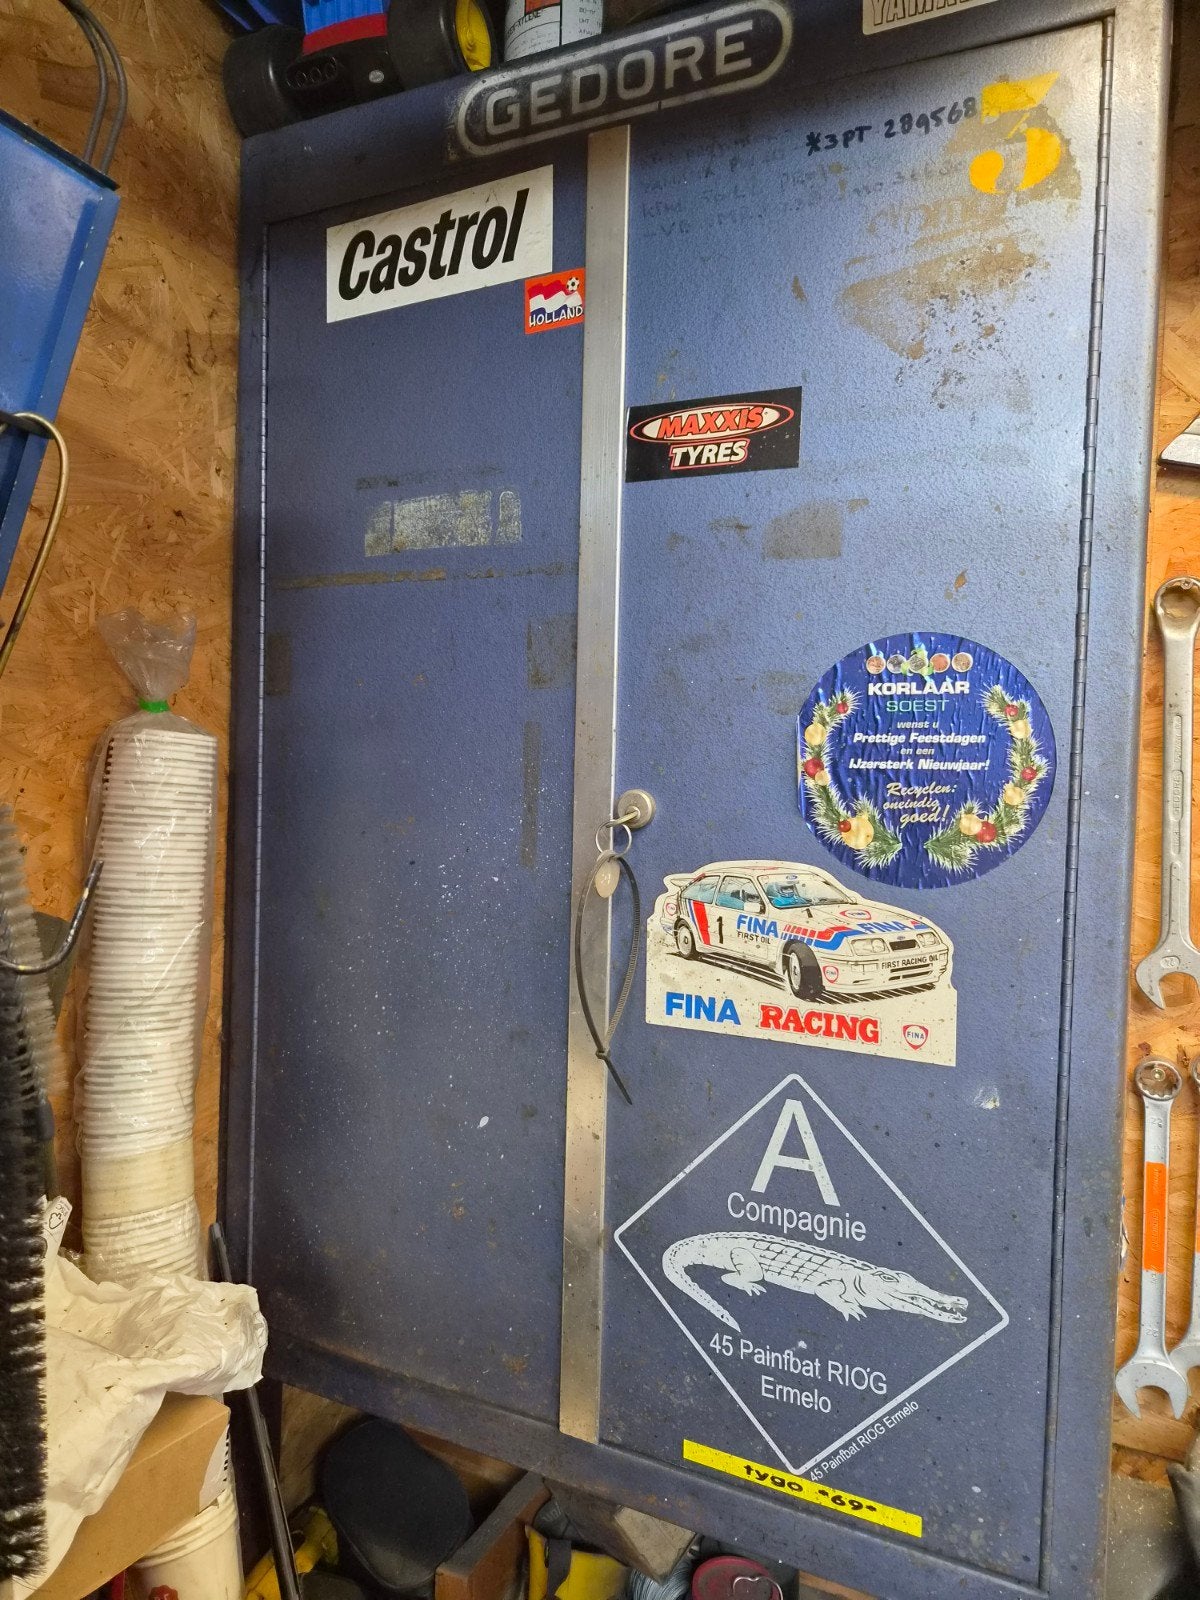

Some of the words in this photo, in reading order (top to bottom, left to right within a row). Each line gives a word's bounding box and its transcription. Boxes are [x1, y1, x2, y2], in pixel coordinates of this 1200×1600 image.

[484, 20, 755, 136] GEDORE
[338, 188, 530, 302] Castrol
[528, 306, 584, 328] HOLLAND
[656, 407, 766, 439] MAXXIS
[672, 440, 747, 467] TYRES
[868, 681, 970, 696] KORLAAR
[886, 700, 950, 712] SOEST
[897, 721, 929, 729] wenst
[853, 733, 906, 746] Prettige
[909, 733, 986, 746] Feestdagen
[849, 759, 914, 770] IJzersterk
[918, 759, 990, 771] Nieuwjaar!
[886, 782, 957, 797] Recyclen:
[883, 798, 940, 812] oneindig
[900, 804, 950, 828] goed!
[716, 915, 724, 944] 1
[736, 914, 779, 938] FINA
[737, 931, 759, 942] FIRST
[761, 935, 771, 945] OIL
[857, 920, 910, 934] FINA
[881, 959, 900, 970] FIRST
[901, 956, 927, 967] RACING
[929, 954, 939, 963] OIL
[666, 991, 741, 1026] FINA
[759, 1003, 880, 1044] RACING
[907, 1031, 925, 1041] FINA
[751, 1098, 840, 1207] A
[727, 1191, 867, 1242] Compagnie
[709, 1333, 733, 1357] 45
[740, 1339, 821, 1379] Painfbat
[828, 1360, 887, 1395] RIOG
[761, 1375, 832, 1413] Ermelo
[809, 1468, 824, 1482] 45
[823, 1443, 860, 1474] Painfbat
[857, 1424, 886, 1446] RIOG
[884, 1400, 919, 1429] Ermelo
[744, 1464, 804, 1492] tygo
